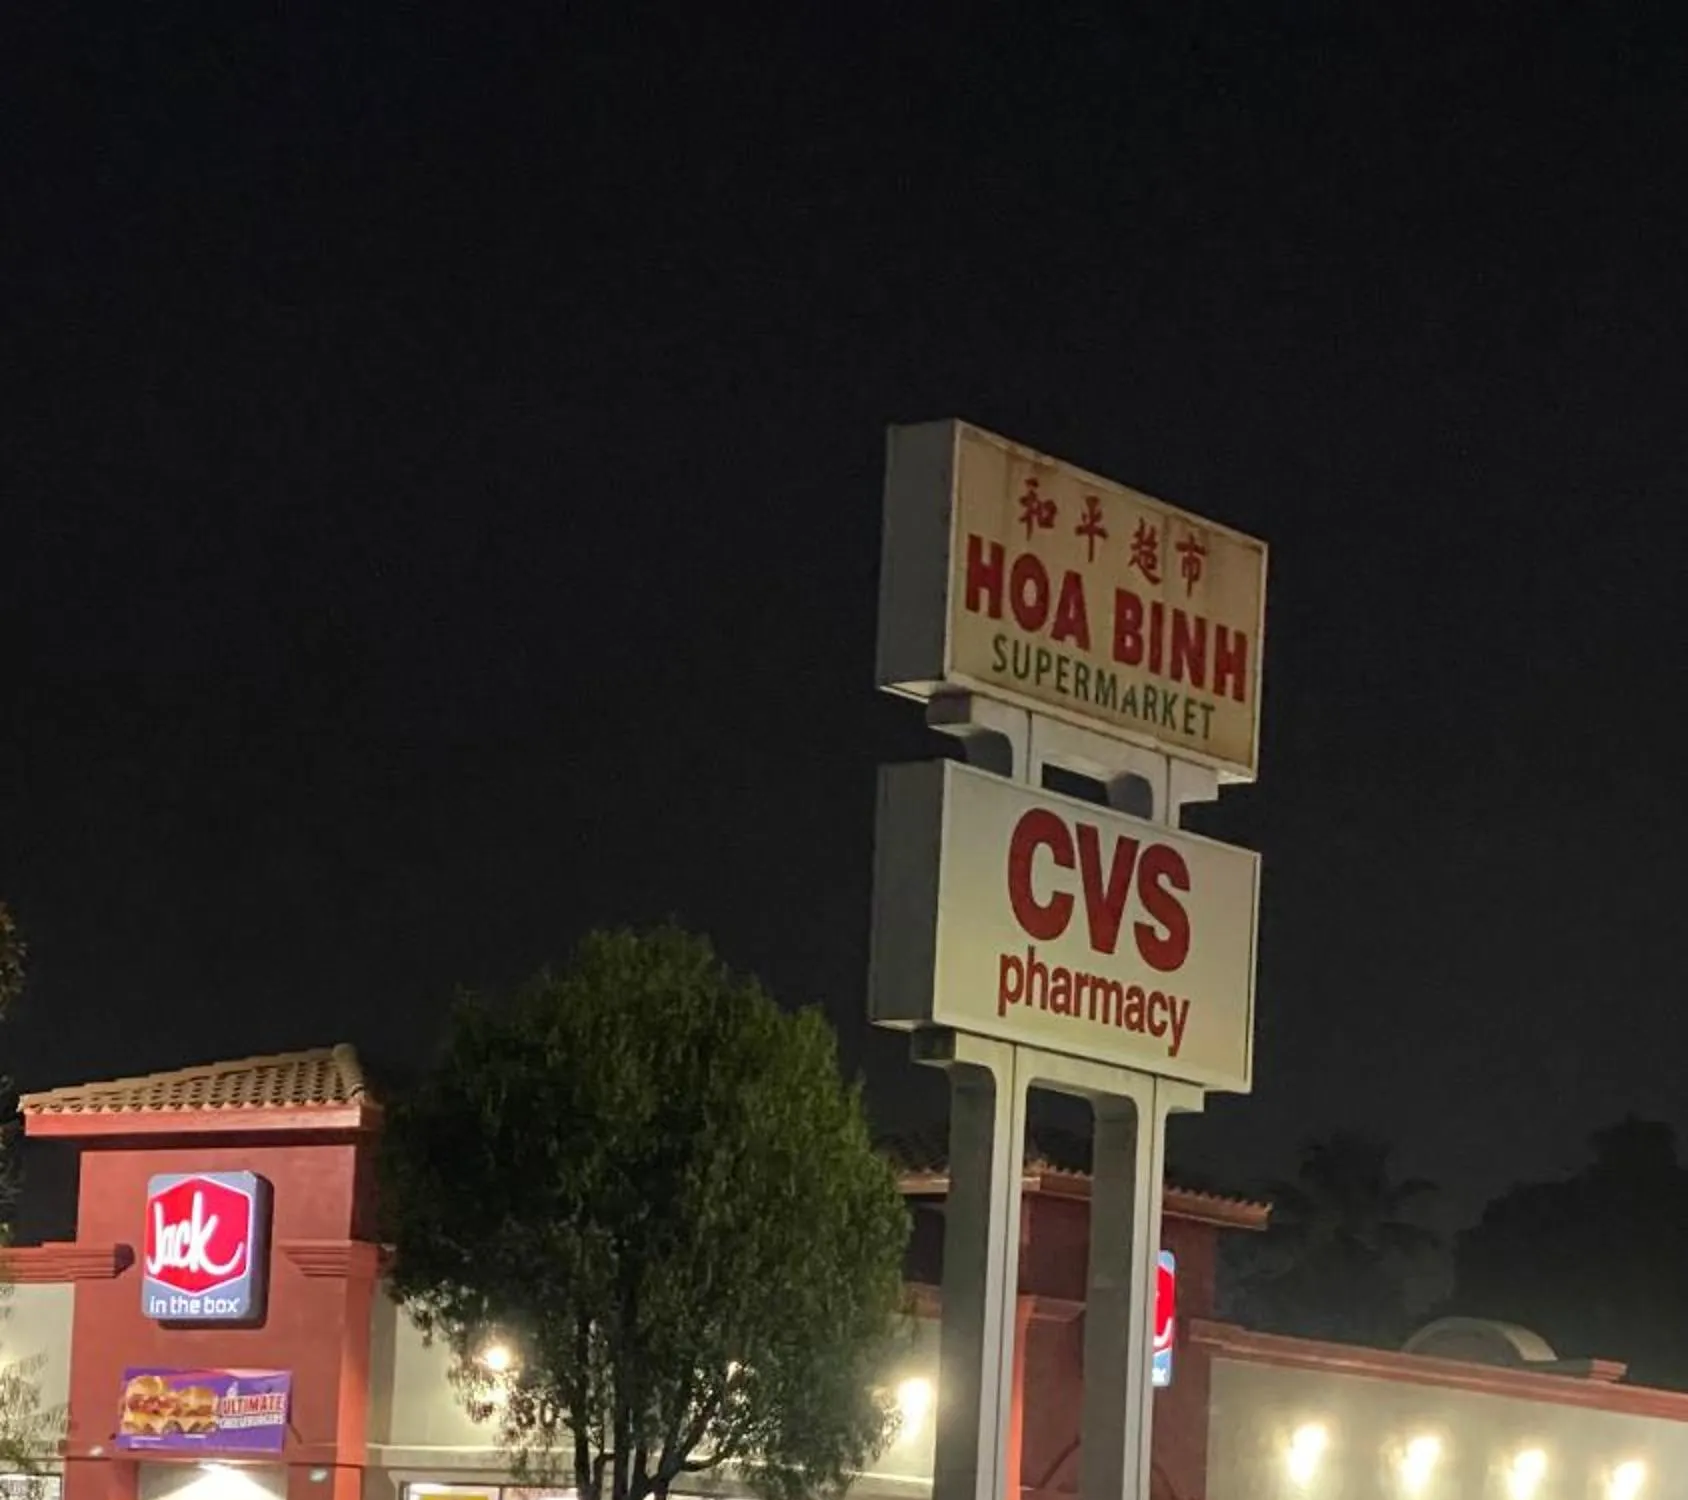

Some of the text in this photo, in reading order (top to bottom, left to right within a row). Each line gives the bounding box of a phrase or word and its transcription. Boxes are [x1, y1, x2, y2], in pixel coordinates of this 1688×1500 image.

[1019, 478, 1207, 598] 和平超市
[965, 533, 1248, 703] HOA BINH
[991, 633, 1215, 741] SUPERMARKET
[1007, 807, 1191, 973] CVS
[997, 945, 1191, 1057] pharmacy
[146, 1190, 244, 1275] Jack
[149, 1296, 240, 1314] in the box
